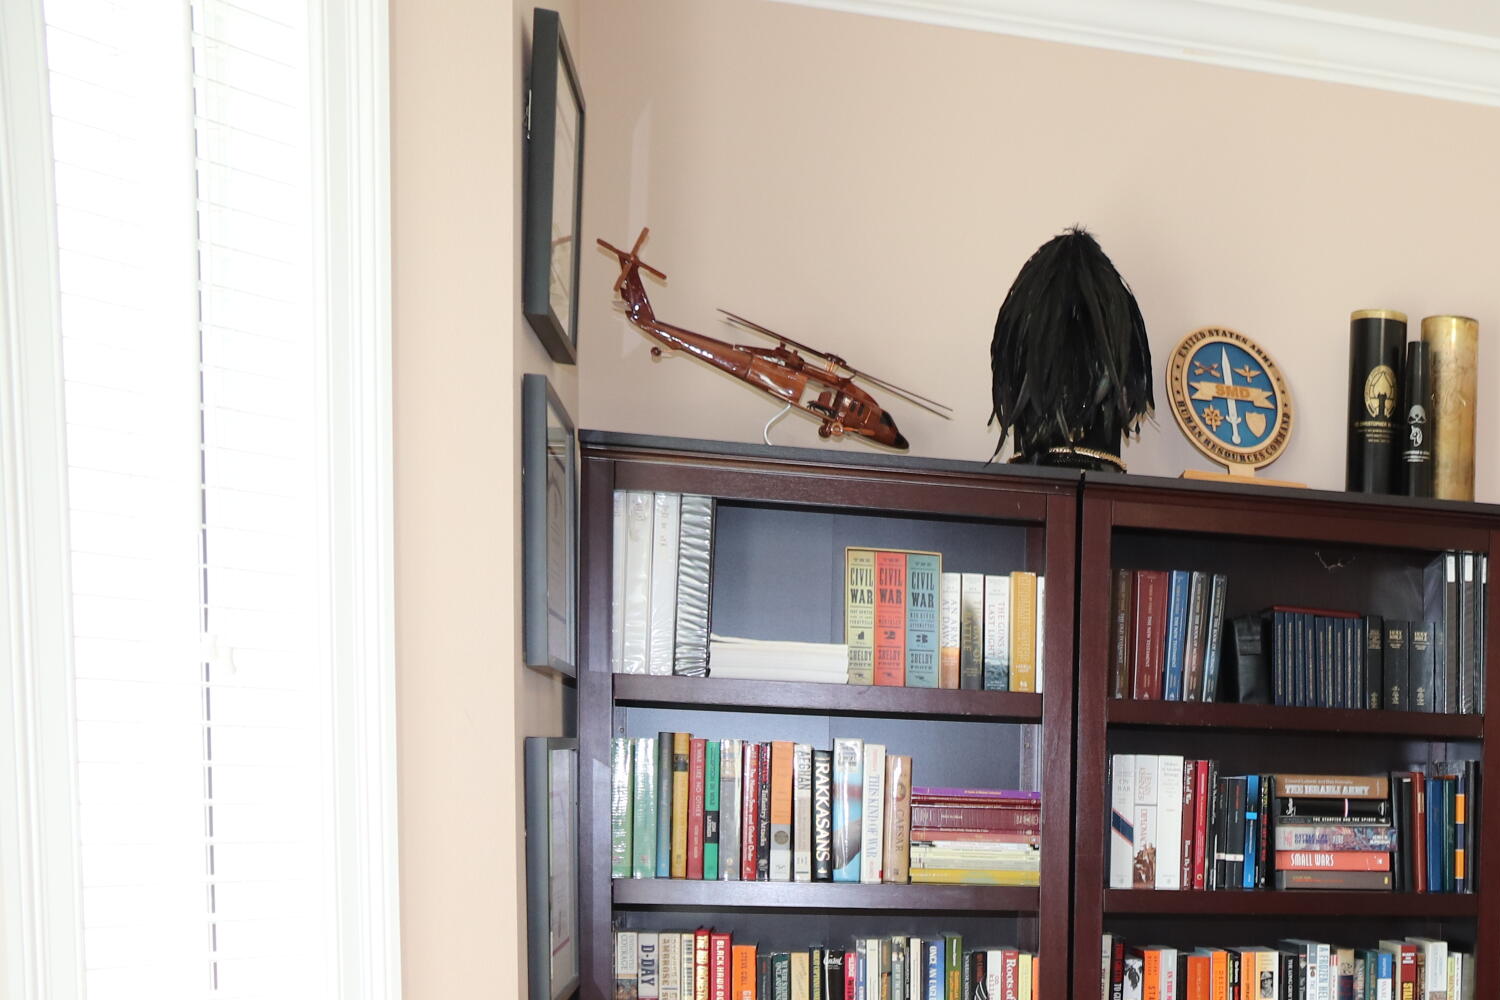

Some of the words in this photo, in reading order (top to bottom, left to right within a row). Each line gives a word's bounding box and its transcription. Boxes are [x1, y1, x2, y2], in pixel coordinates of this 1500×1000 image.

[1178, 331, 1206, 358] UNITED
[1207, 328, 1248, 344] STATES
[1251, 344, 1274, 368] ARMY
[1216, 385, 1250, 398] SMD
[1177, 400, 1202, 437] HUMAN
[1203, 436, 1265, 462] RESOURCES
[1266, 412, 1291, 454] COMMAND
[850, 568, 873, 586] CIVIL
[880, 568, 902, 586] CIVIL
[912, 572, 934, 590] CIVIL
[850, 588, 872, 604] WAR
[880, 588, 902, 604] WAR
[912, 592, 934, 608] WAR
[943, 600, 950, 611] AT
[952, 600, 958, 614] AN
[850, 650, 872, 661] SHELBY
[879, 650, 900, 660] SHELBY
[911, 654, 933, 664] SHELBY
[798, 751, 810, 790] AFGHAN
[695, 782, 702, 792] NO
[867, 776, 880, 798] THIS
[1285, 785, 1303, 794] THE
[1342, 786, 1369, 795] ARMY
[816, 762, 830, 860] RAKKASANS
[867, 798, 880, 822] KIND
[867, 824, 878, 836] OF
[896, 809, 904, 852] CAESAR
[866, 838, 878, 858] WAR
[1291, 853, 1312, 866] SMALL
[1314, 854, 1334, 866] WARS
[929, 946, 938, 964] ONCE
[929, 968, 938, 978] AN
[1006, 958, 1016, 990] Roots
[1318, 955, 1328, 982] FROZEN
[1300, 977, 1305, 986] No
